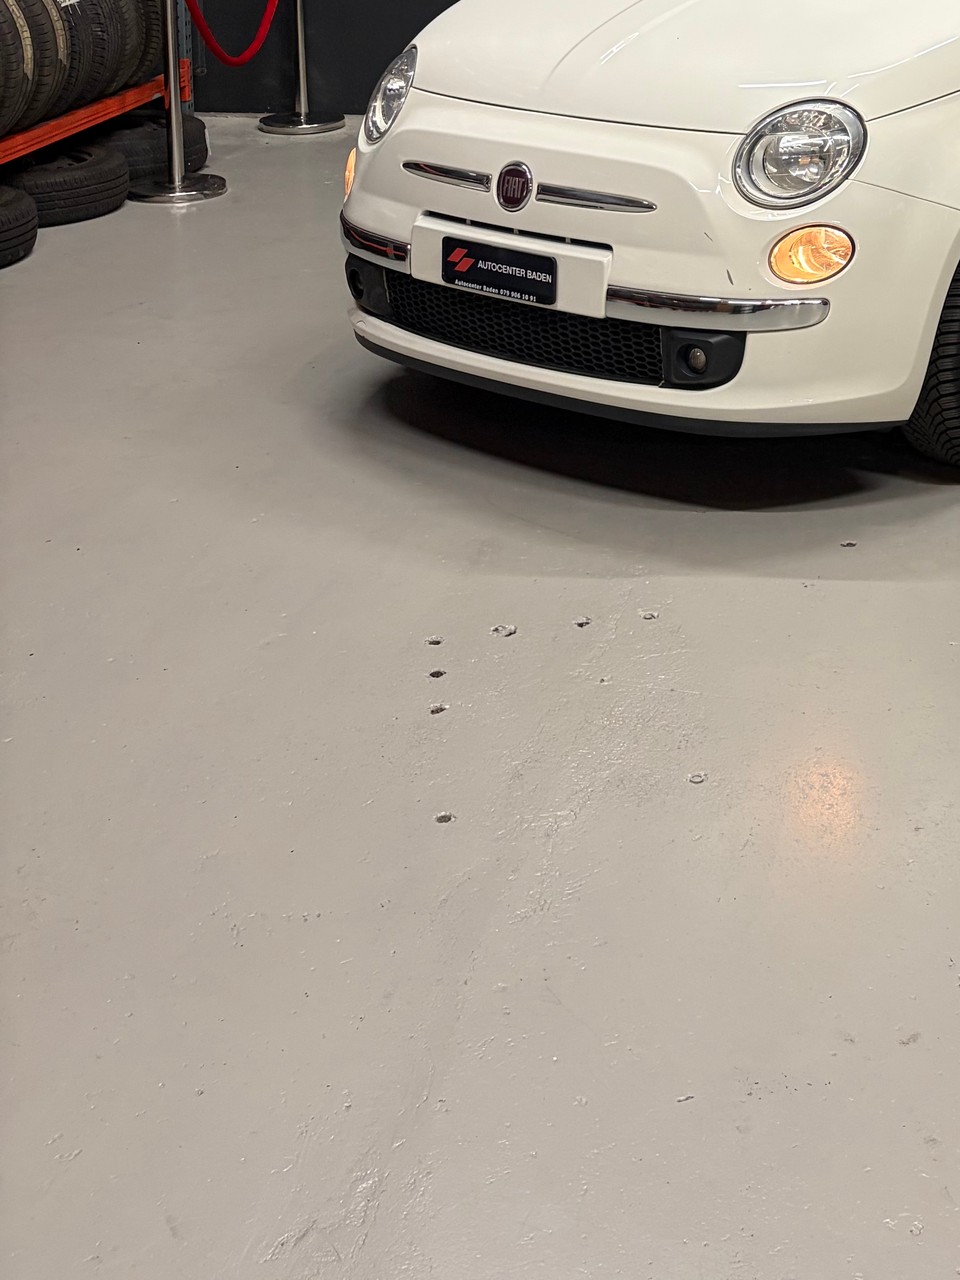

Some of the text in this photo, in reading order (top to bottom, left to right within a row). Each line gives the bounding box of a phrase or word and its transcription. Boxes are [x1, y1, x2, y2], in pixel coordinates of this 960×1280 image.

[503, 176, 526, 198] FIAT
[477, 260, 552, 283] AUTOCENTER BADEN
[454, 279, 482, 289] Autocenter
[483, 285, 499, 293] Baden
